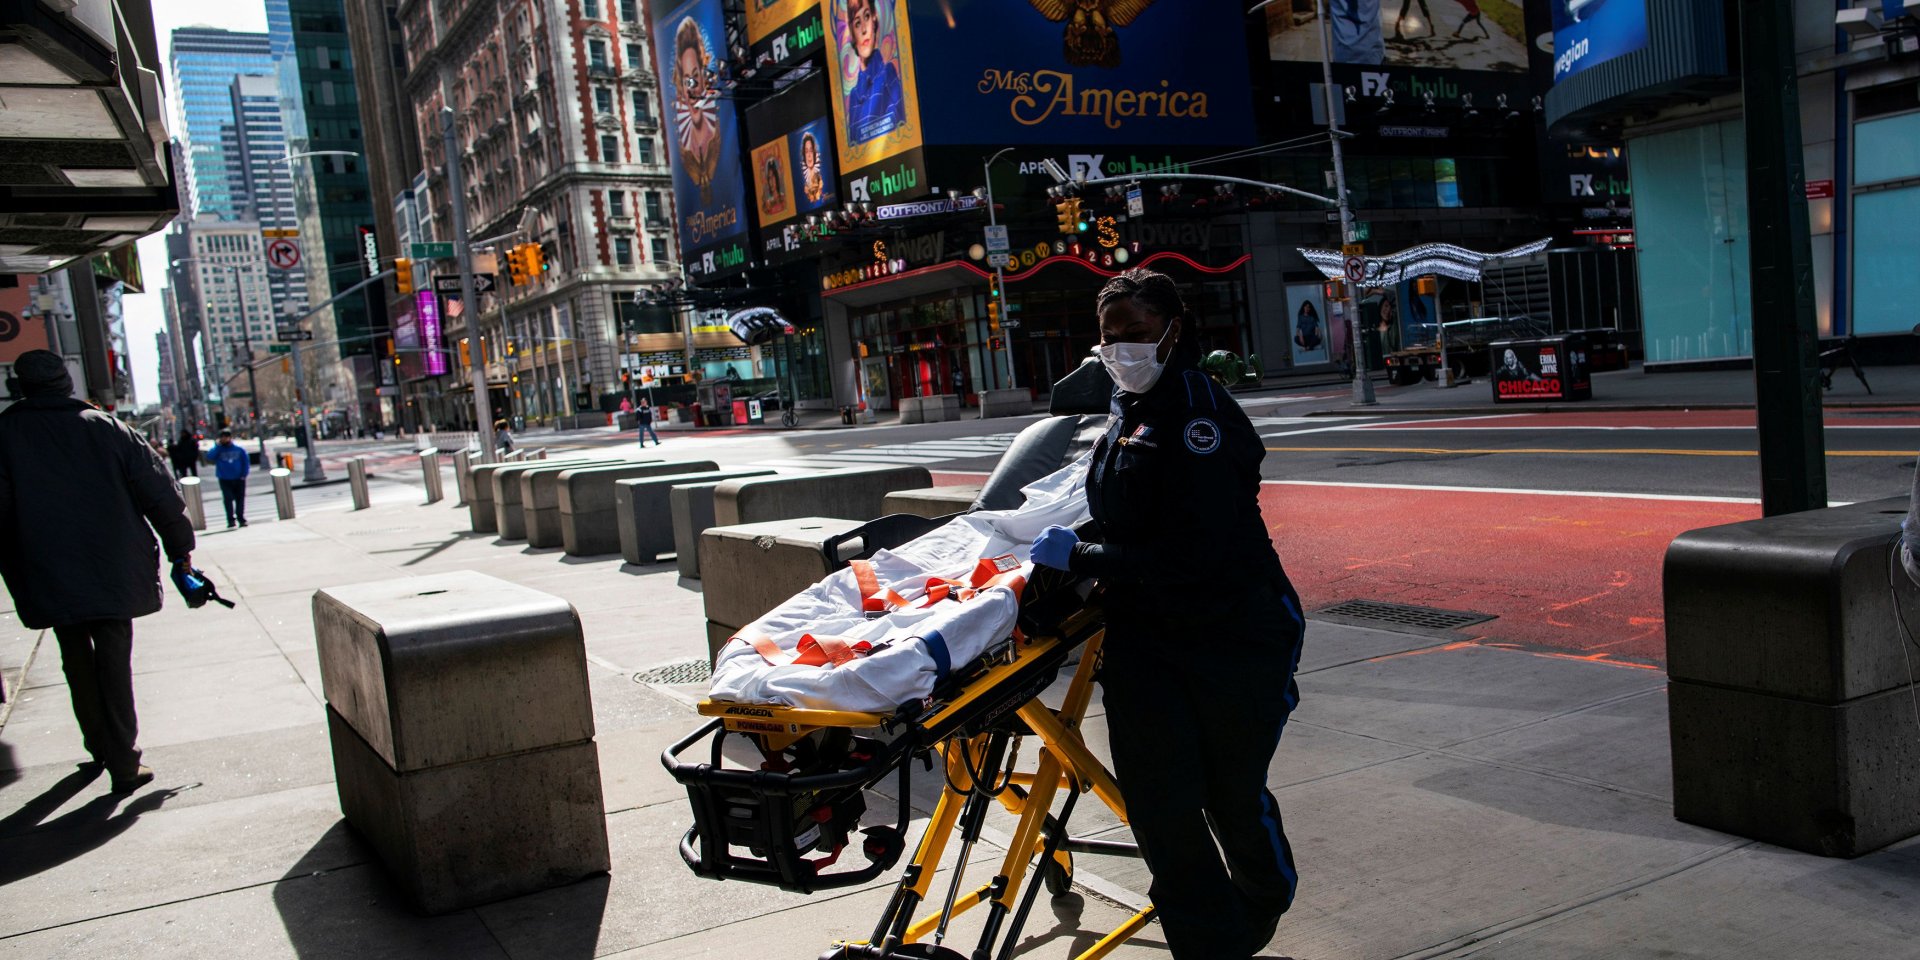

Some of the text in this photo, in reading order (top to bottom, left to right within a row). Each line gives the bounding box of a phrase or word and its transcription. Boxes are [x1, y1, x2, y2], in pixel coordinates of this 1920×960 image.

[772, 32, 789, 63] FX
[1361, 71, 1391, 97] FX
[1410, 75, 1459, 99] hulu
[977, 69, 1209, 129] Mrs. America
[1067, 154, 1106, 180] FX
[1108, 161, 1127, 174] ON
[850, 164, 917, 203] FX ON hulu
[1569, 174, 1596, 197] FX
[880, 201, 944, 219] OUTFRONT
[691, 204, 737, 243] America
[702, 250, 717, 275] FX
[722, 243, 745, 268] hulu
[1539, 354, 1557, 365] ERIKA
[1541, 364, 1558, 375] JAYNE
[1498, 378, 1561, 395] CHICAGO
[730, 707, 768, 717] RUGGED
[736, 721, 784, 733] POWERLOAD
